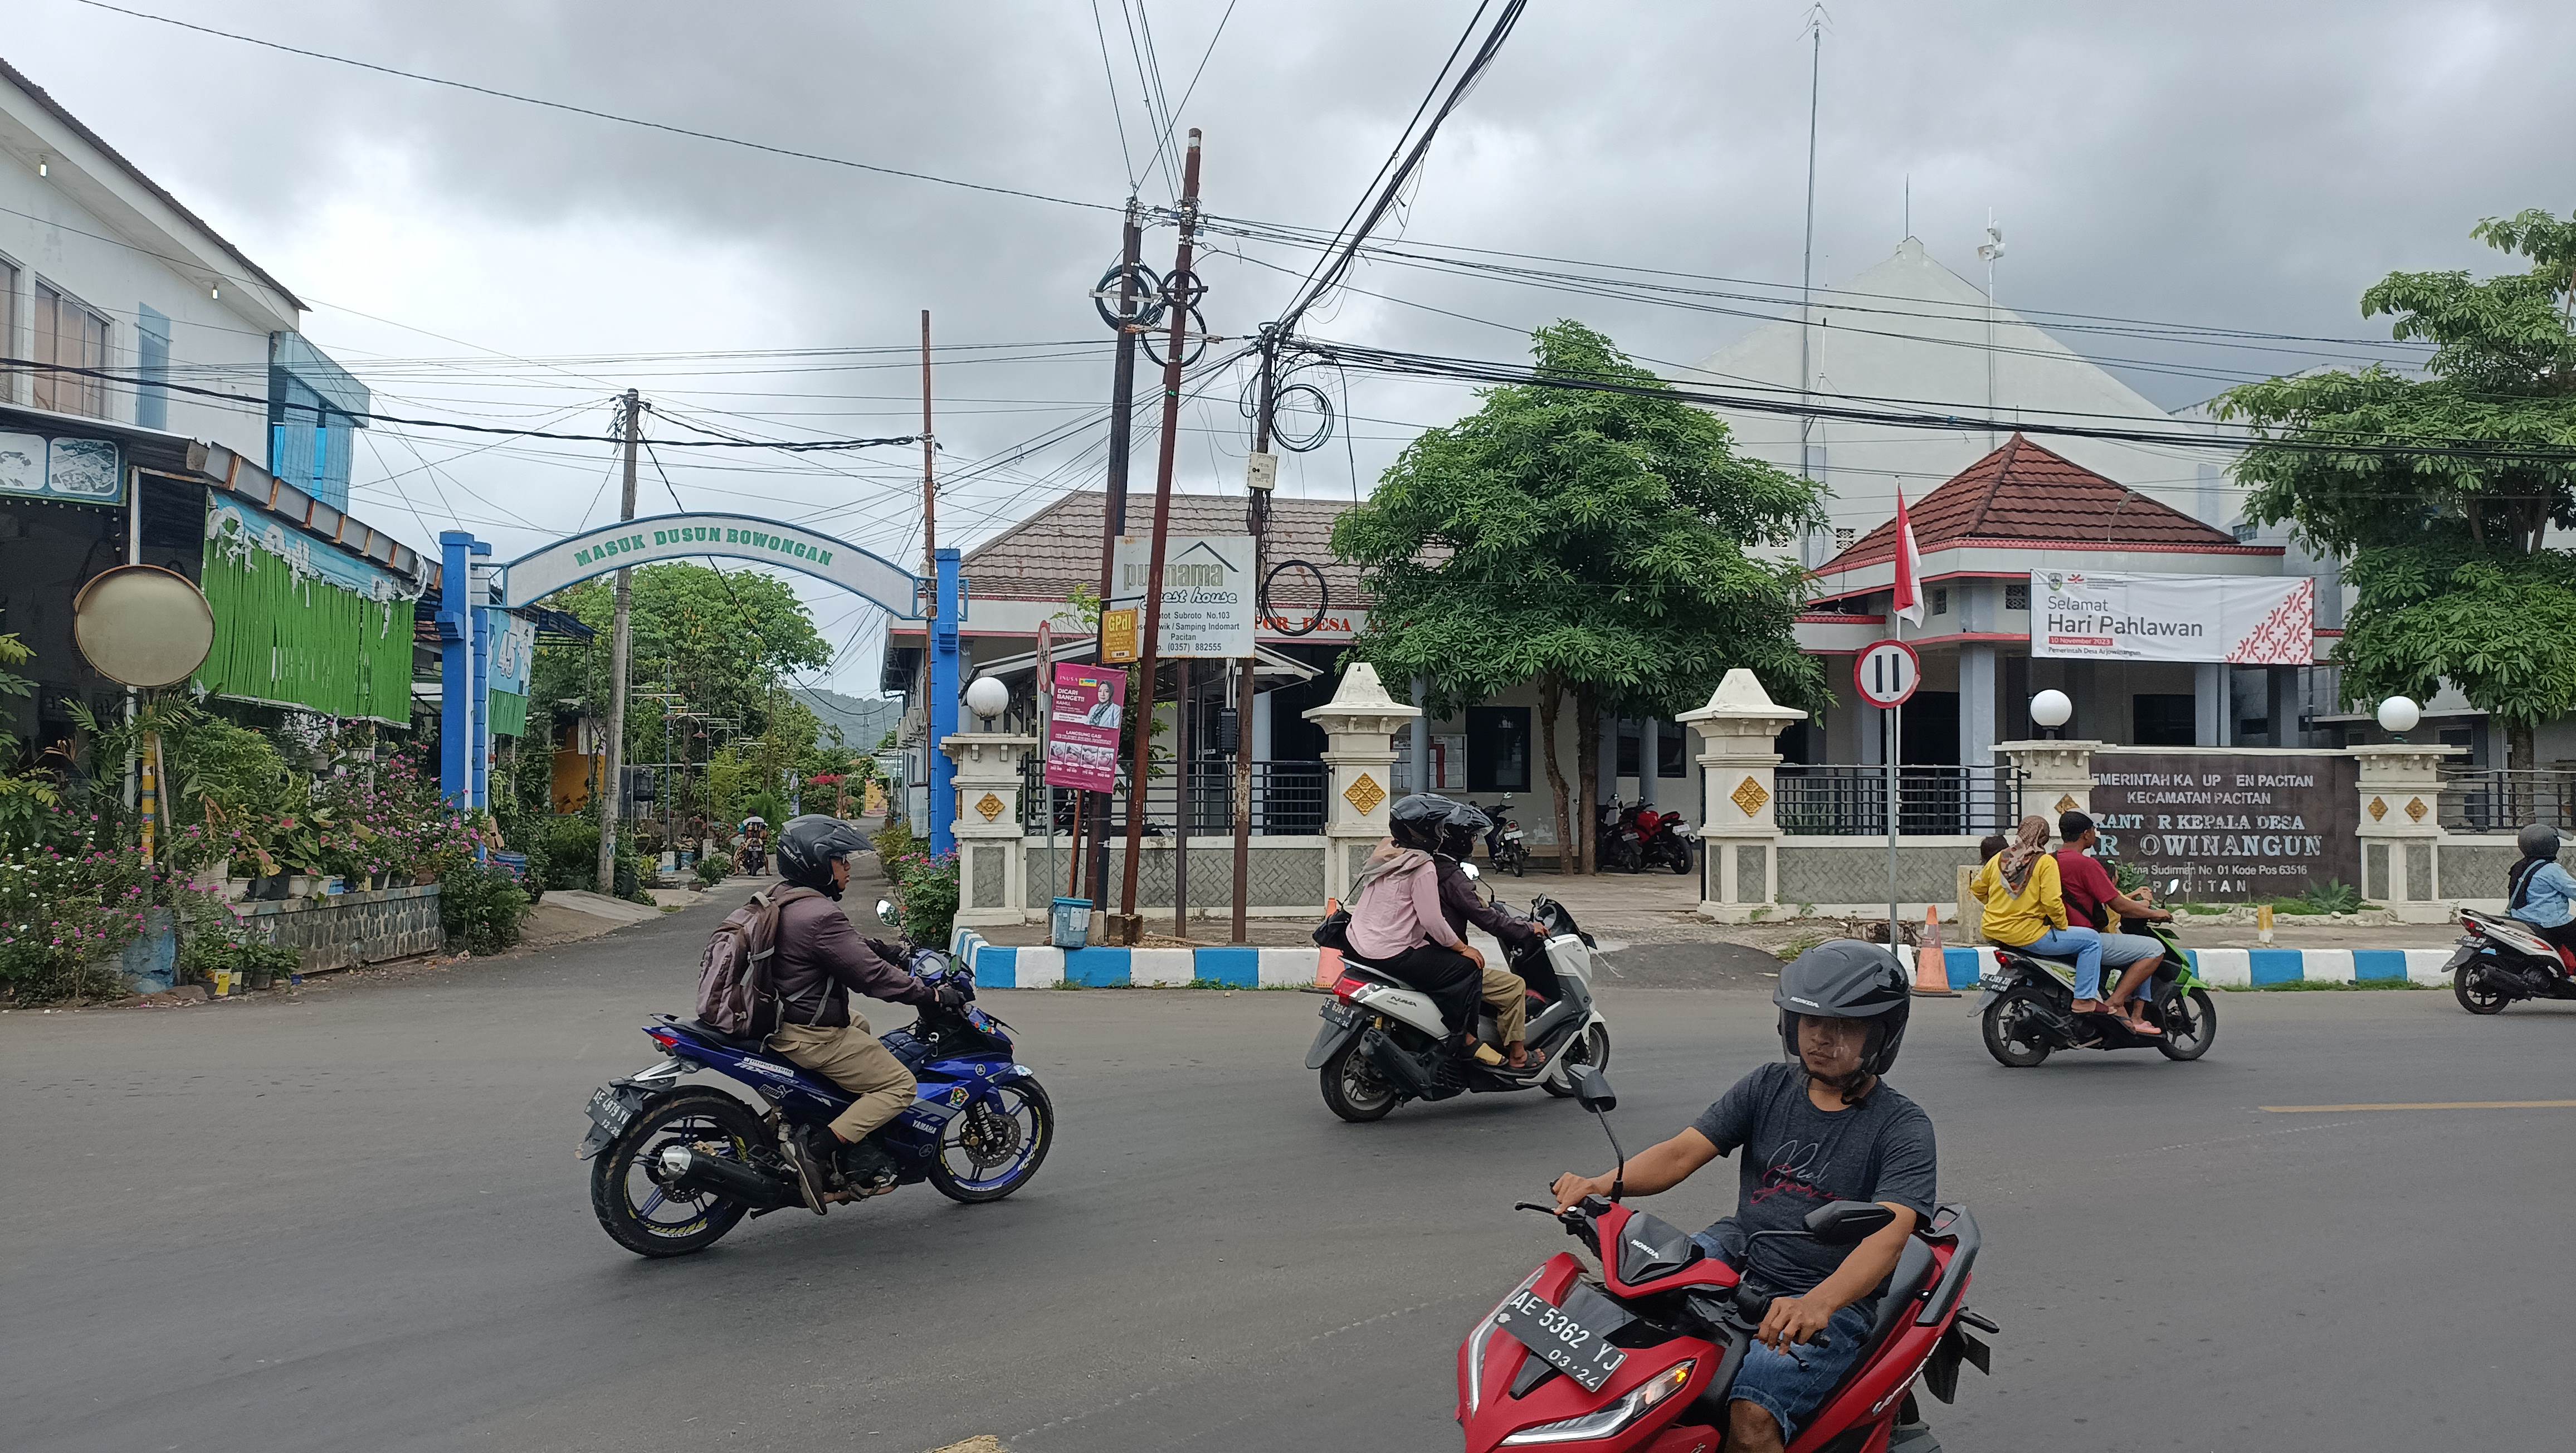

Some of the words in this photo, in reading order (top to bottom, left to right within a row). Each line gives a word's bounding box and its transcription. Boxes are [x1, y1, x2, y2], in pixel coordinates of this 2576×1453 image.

[574, 534, 646, 567] MASUK
[654, 527, 721, 546] DUSUN
[726, 528, 833, 565] BOWONGAN
[1124, 564, 1223, 591] punama
[1140, 589, 1187, 610] gest
[1191, 587, 1237, 603] house
[2048, 596, 2108, 612] Selamat
[1175, 623, 1206, 632] Samping
[1301, 617, 1353, 632] DESA
[2048, 614, 2091, 633] Hari
[2100, 616, 2203, 637] Pahlawan
[1168, 643, 1190, 652] (0357)
[1195, 643, 1222, 651] 882555
[2089, 773, 2170, 786] EMERINTAH
[2258, 775, 2313, 787] PACITAN
[2127, 791, 2211, 804] KECAMATAN
[2214, 792, 2271, 804] PACITAN
[2177, 815, 2251, 830] KEPALA
[2256, 815, 2305, 830] DESA
[2151, 865, 2196, 875] Sudirman
[2199, 866, 2213, 875] No
[2217, 865, 2229, 875] 01
[2259, 865, 2277, 875] Pos
[2279, 865, 2307, 875] 63516
[593, 1090, 606, 1105] AE
[618, 1109, 632, 1125] YV
[912, 1119, 937, 1134] YAMAHA
[1630, 1239, 1660, 1259] HONDA
[1510, 1291, 1543, 1315] AE
[1539, 1308, 1590, 1349] 5362
[1593, 1343, 1626, 1371] YJ
